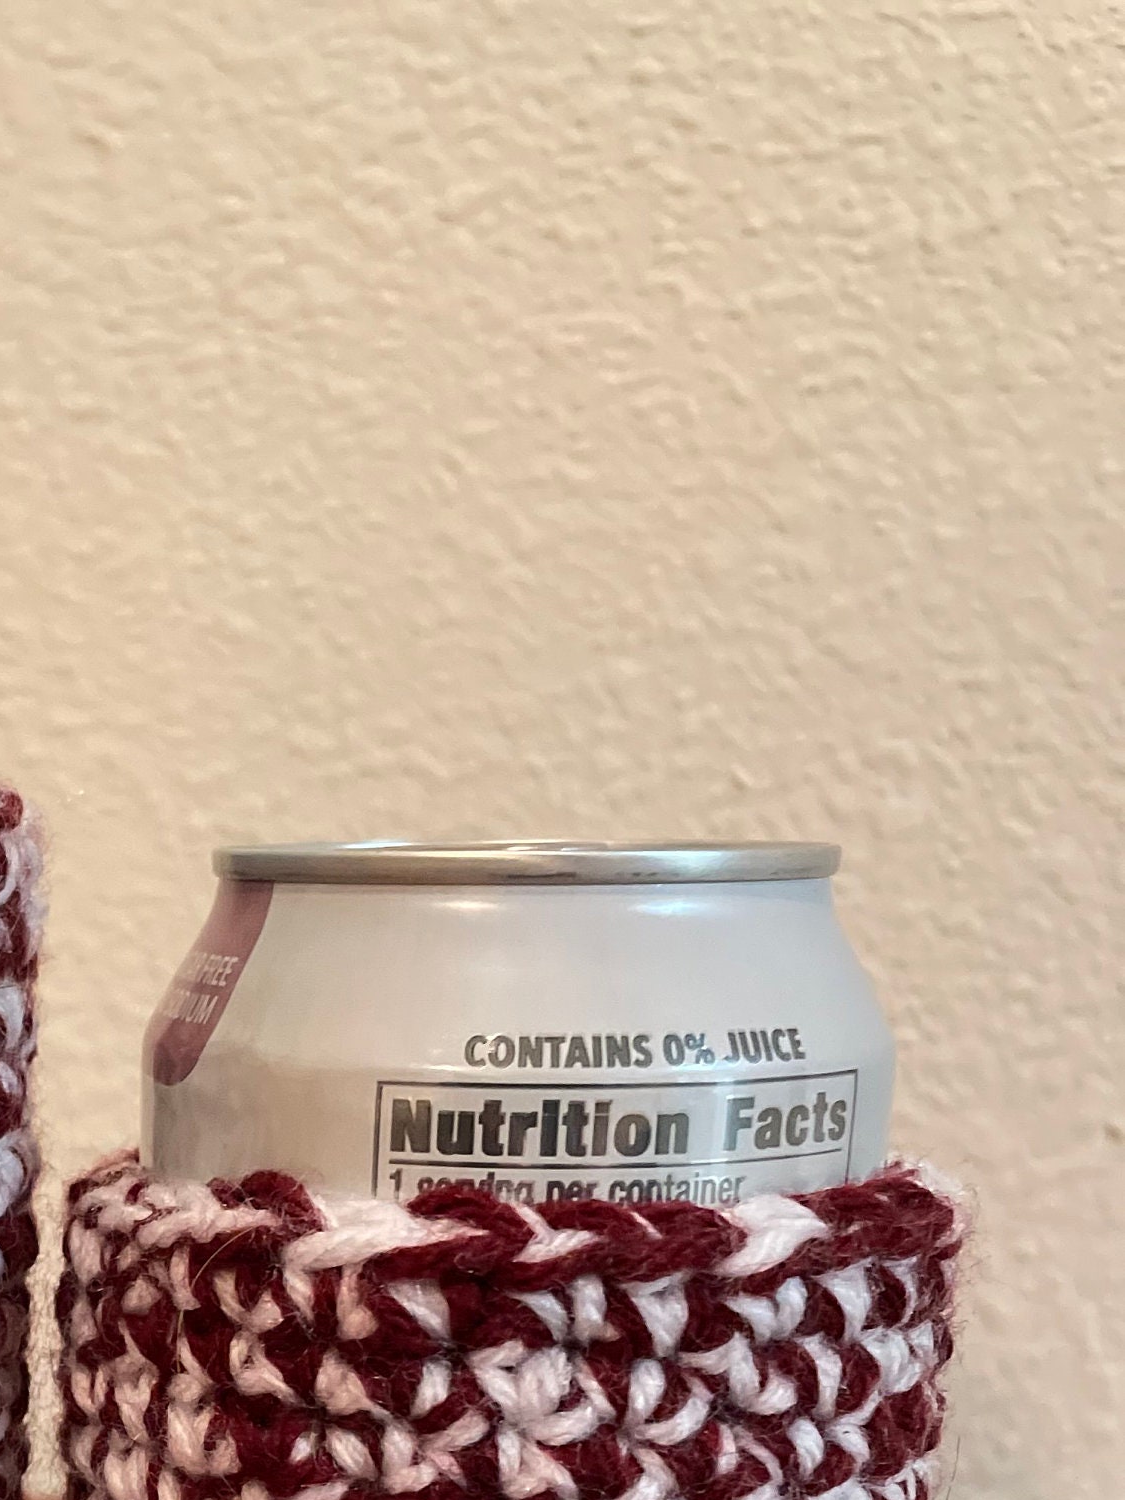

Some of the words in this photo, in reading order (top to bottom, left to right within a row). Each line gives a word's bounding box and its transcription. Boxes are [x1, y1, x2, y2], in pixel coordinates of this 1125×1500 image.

[463, 1033, 653, 1069] CONTAINS
[662, 1032, 716, 1066] 0%
[724, 1027, 807, 1064] JUICE
[389, 1098, 691, 1158] Nutrition
[724, 1091, 848, 1152] Facts
[389, 1168, 403, 1204] 1
[607, 1171, 748, 1206] container
